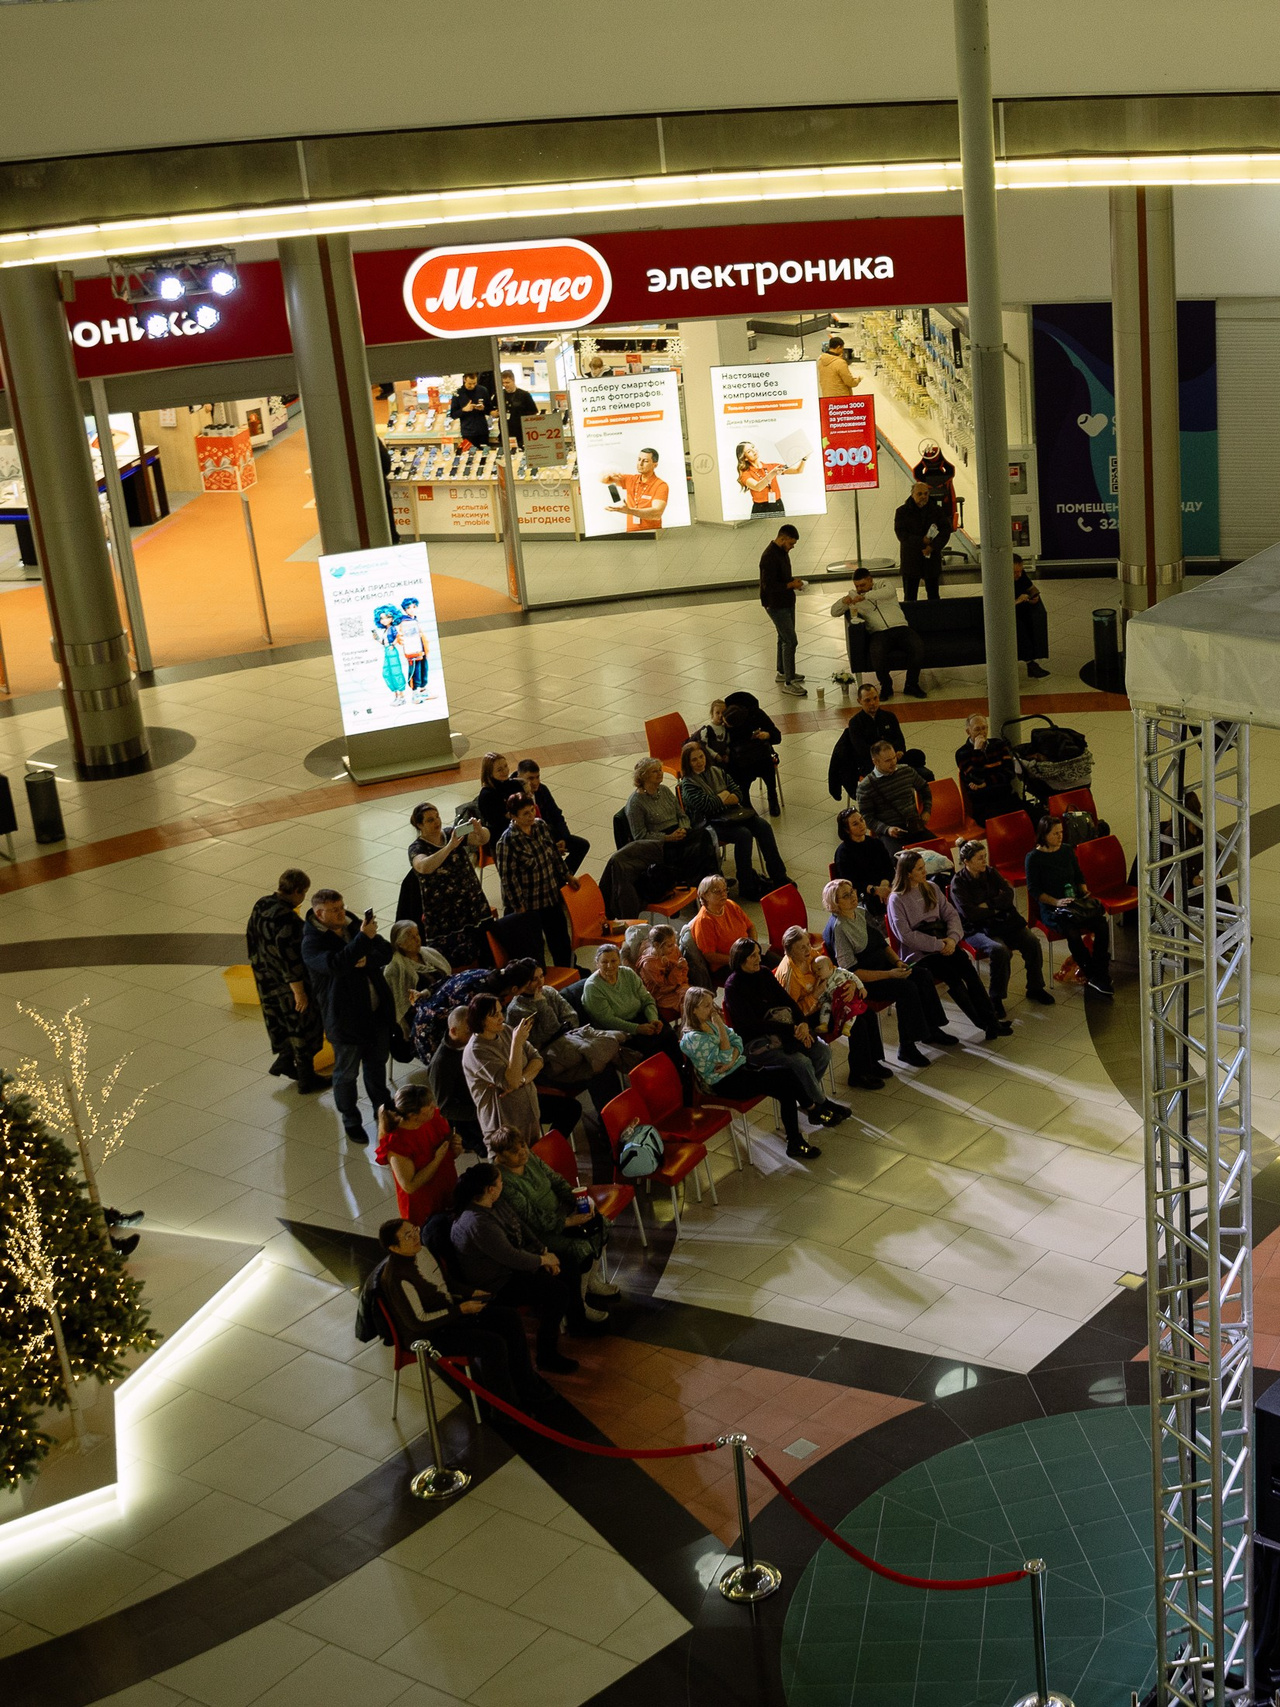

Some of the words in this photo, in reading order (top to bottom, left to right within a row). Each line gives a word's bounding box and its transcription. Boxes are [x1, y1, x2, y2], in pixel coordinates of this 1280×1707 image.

[647, 256, 894, 294] электроника
[425, 267, 594, 315] М.видео
[69, 311, 208, 348] оника
[721, 371, 770, 380] Настоящее
[580, 384, 619, 392] Подберу
[621, 380, 665, 390] смартфон
[723, 381, 761, 390] качество
[763, 379, 779, 387] без
[723, 390, 788, 399] компромиссов
[591, 405, 606, 413] для
[609, 401, 651, 411] геймеров
[825, 444, 872, 467] 3000
[1056, 503, 1119, 514] ПОМЕЩЕН
[1100, 518, 1120, 530] 32
[332, 584, 367, 597] СКАЧАЙ
[367, 578, 424, 592] ПРИЛОЖЕНИЕ
[333, 594, 352, 605] МОЙ
[354, 590, 395, 602] СИБМОЛЛ
